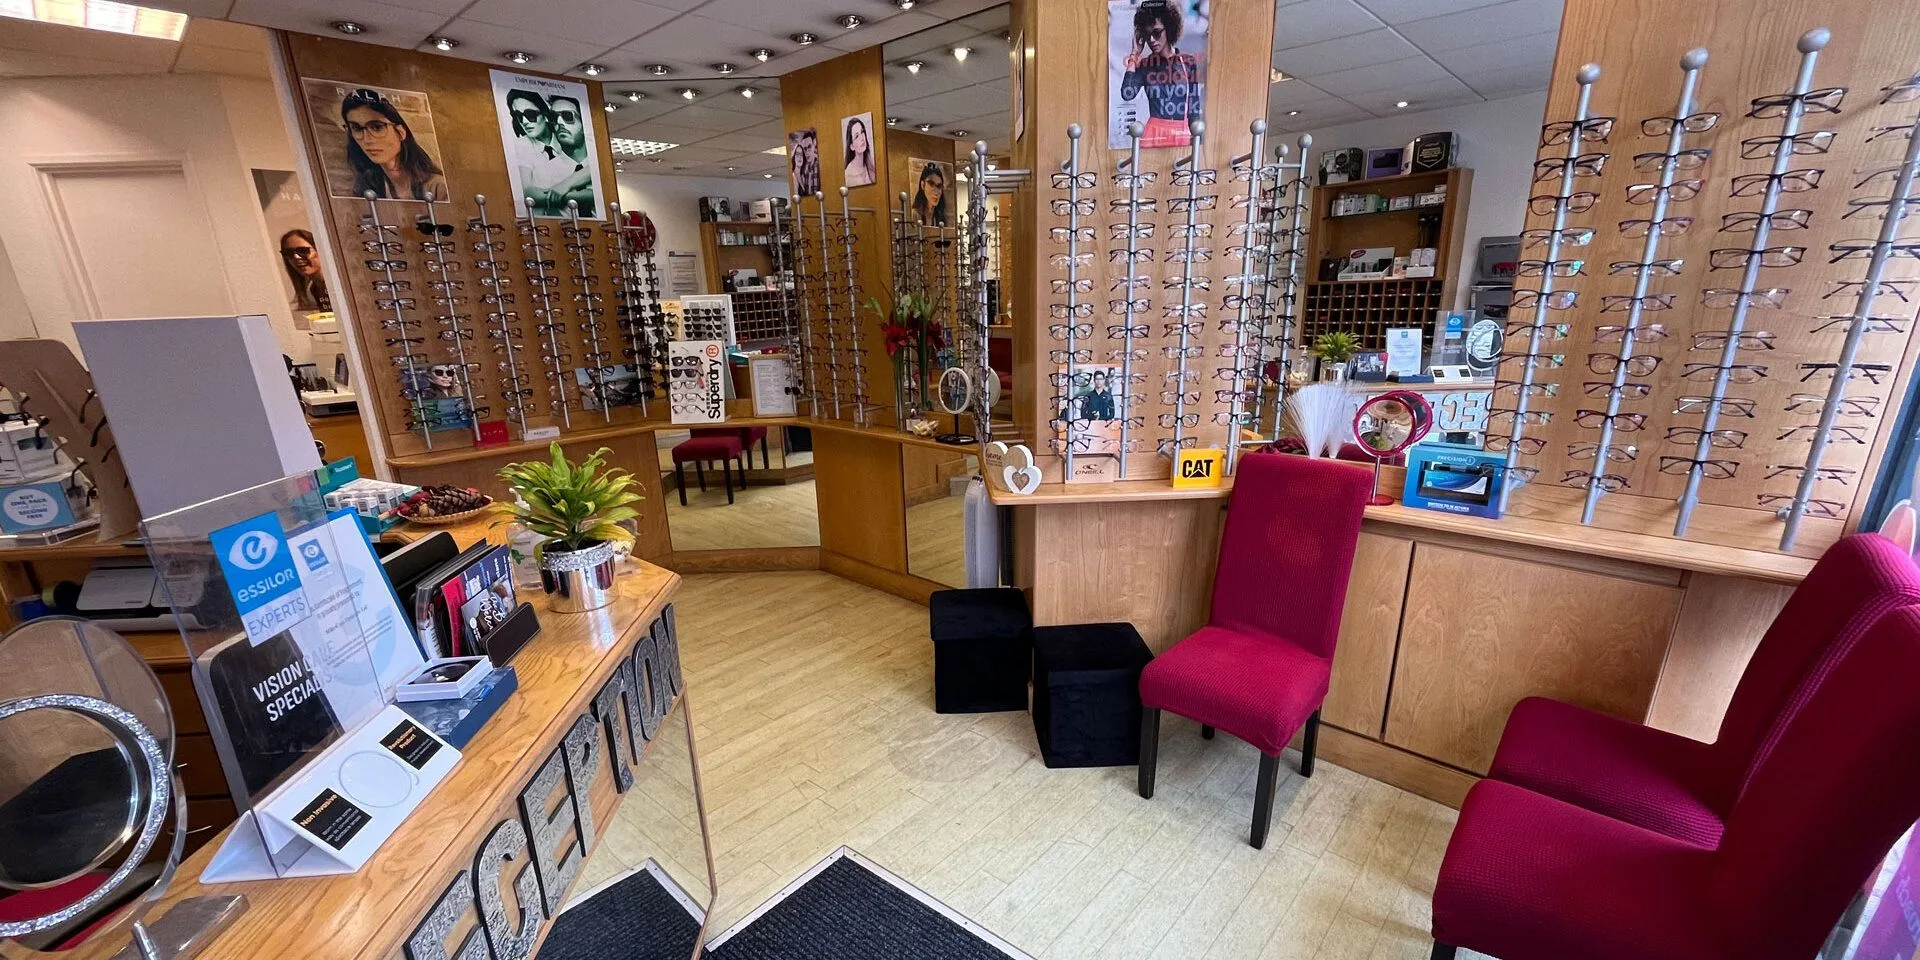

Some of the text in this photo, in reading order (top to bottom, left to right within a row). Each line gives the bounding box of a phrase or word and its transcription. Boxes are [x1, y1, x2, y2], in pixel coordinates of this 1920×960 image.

[336, 86, 401, 103] RALPH
[1182, 459, 1214, 478] CAT
[248, 596, 306, 636] EXPERTS
[252, 661, 303, 703] VISION
[398, 732, 416, 750] Product
[300, 794, 338, 827] Non Invasive
